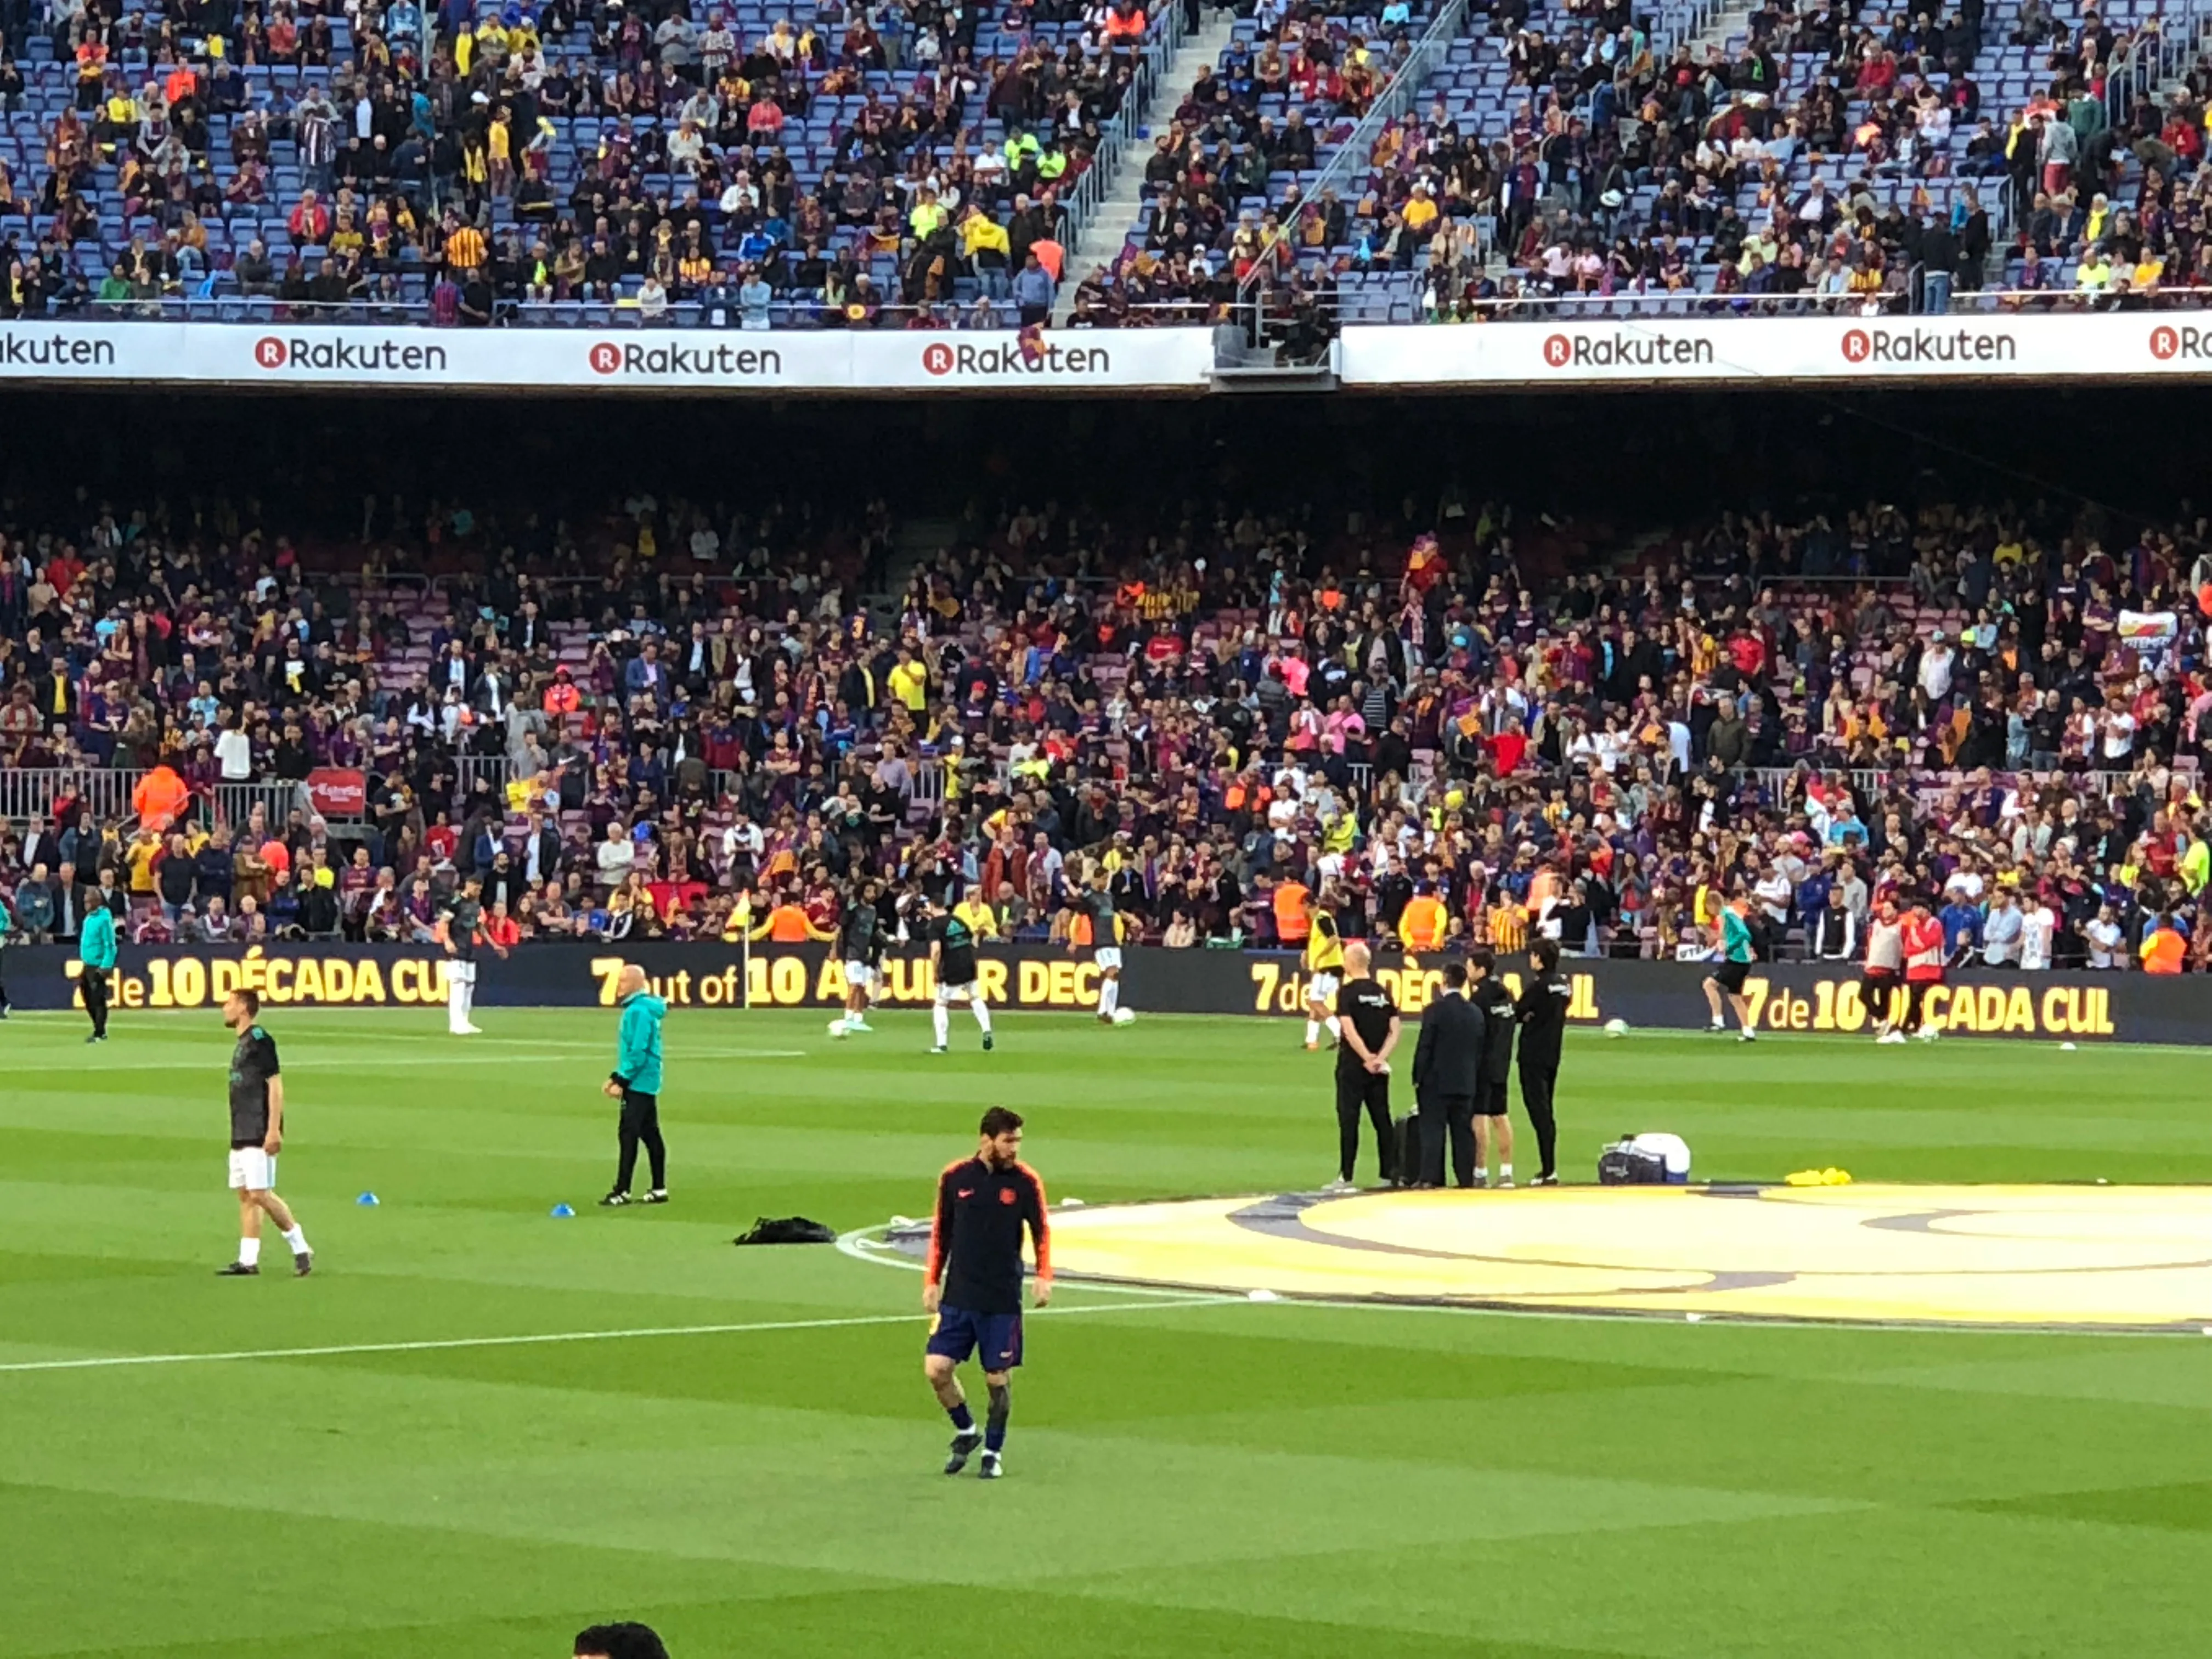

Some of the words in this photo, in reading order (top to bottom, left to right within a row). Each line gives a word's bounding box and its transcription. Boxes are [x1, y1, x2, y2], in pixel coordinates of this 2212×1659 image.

[0, 332, 115, 365] kuten
[290, 337, 446, 370] Rakuten
[624, 342, 781, 374] Rakuten
[1574, 332, 1713, 365] Rakuten
[1872, 328, 2016, 361] Rakuten
[105, 968, 144, 1007] de
[148, 959, 205, 1006] 10
[212, 945, 386, 1002] DÉCADA
[392, 959, 450, 1003] CU
[591, 957, 624, 1006] 7
[644, 969, 691, 1004] ut
[699, 965, 737, 1004] of
[747, 957, 806, 1004] 10
[1251, 964, 1279, 1011] 7
[1742, 979, 1769, 1028] 7
[1769, 988, 1809, 1029] de
[1813, 980, 1866, 1031] 10
[2042, 987, 2114, 1034] CUL
